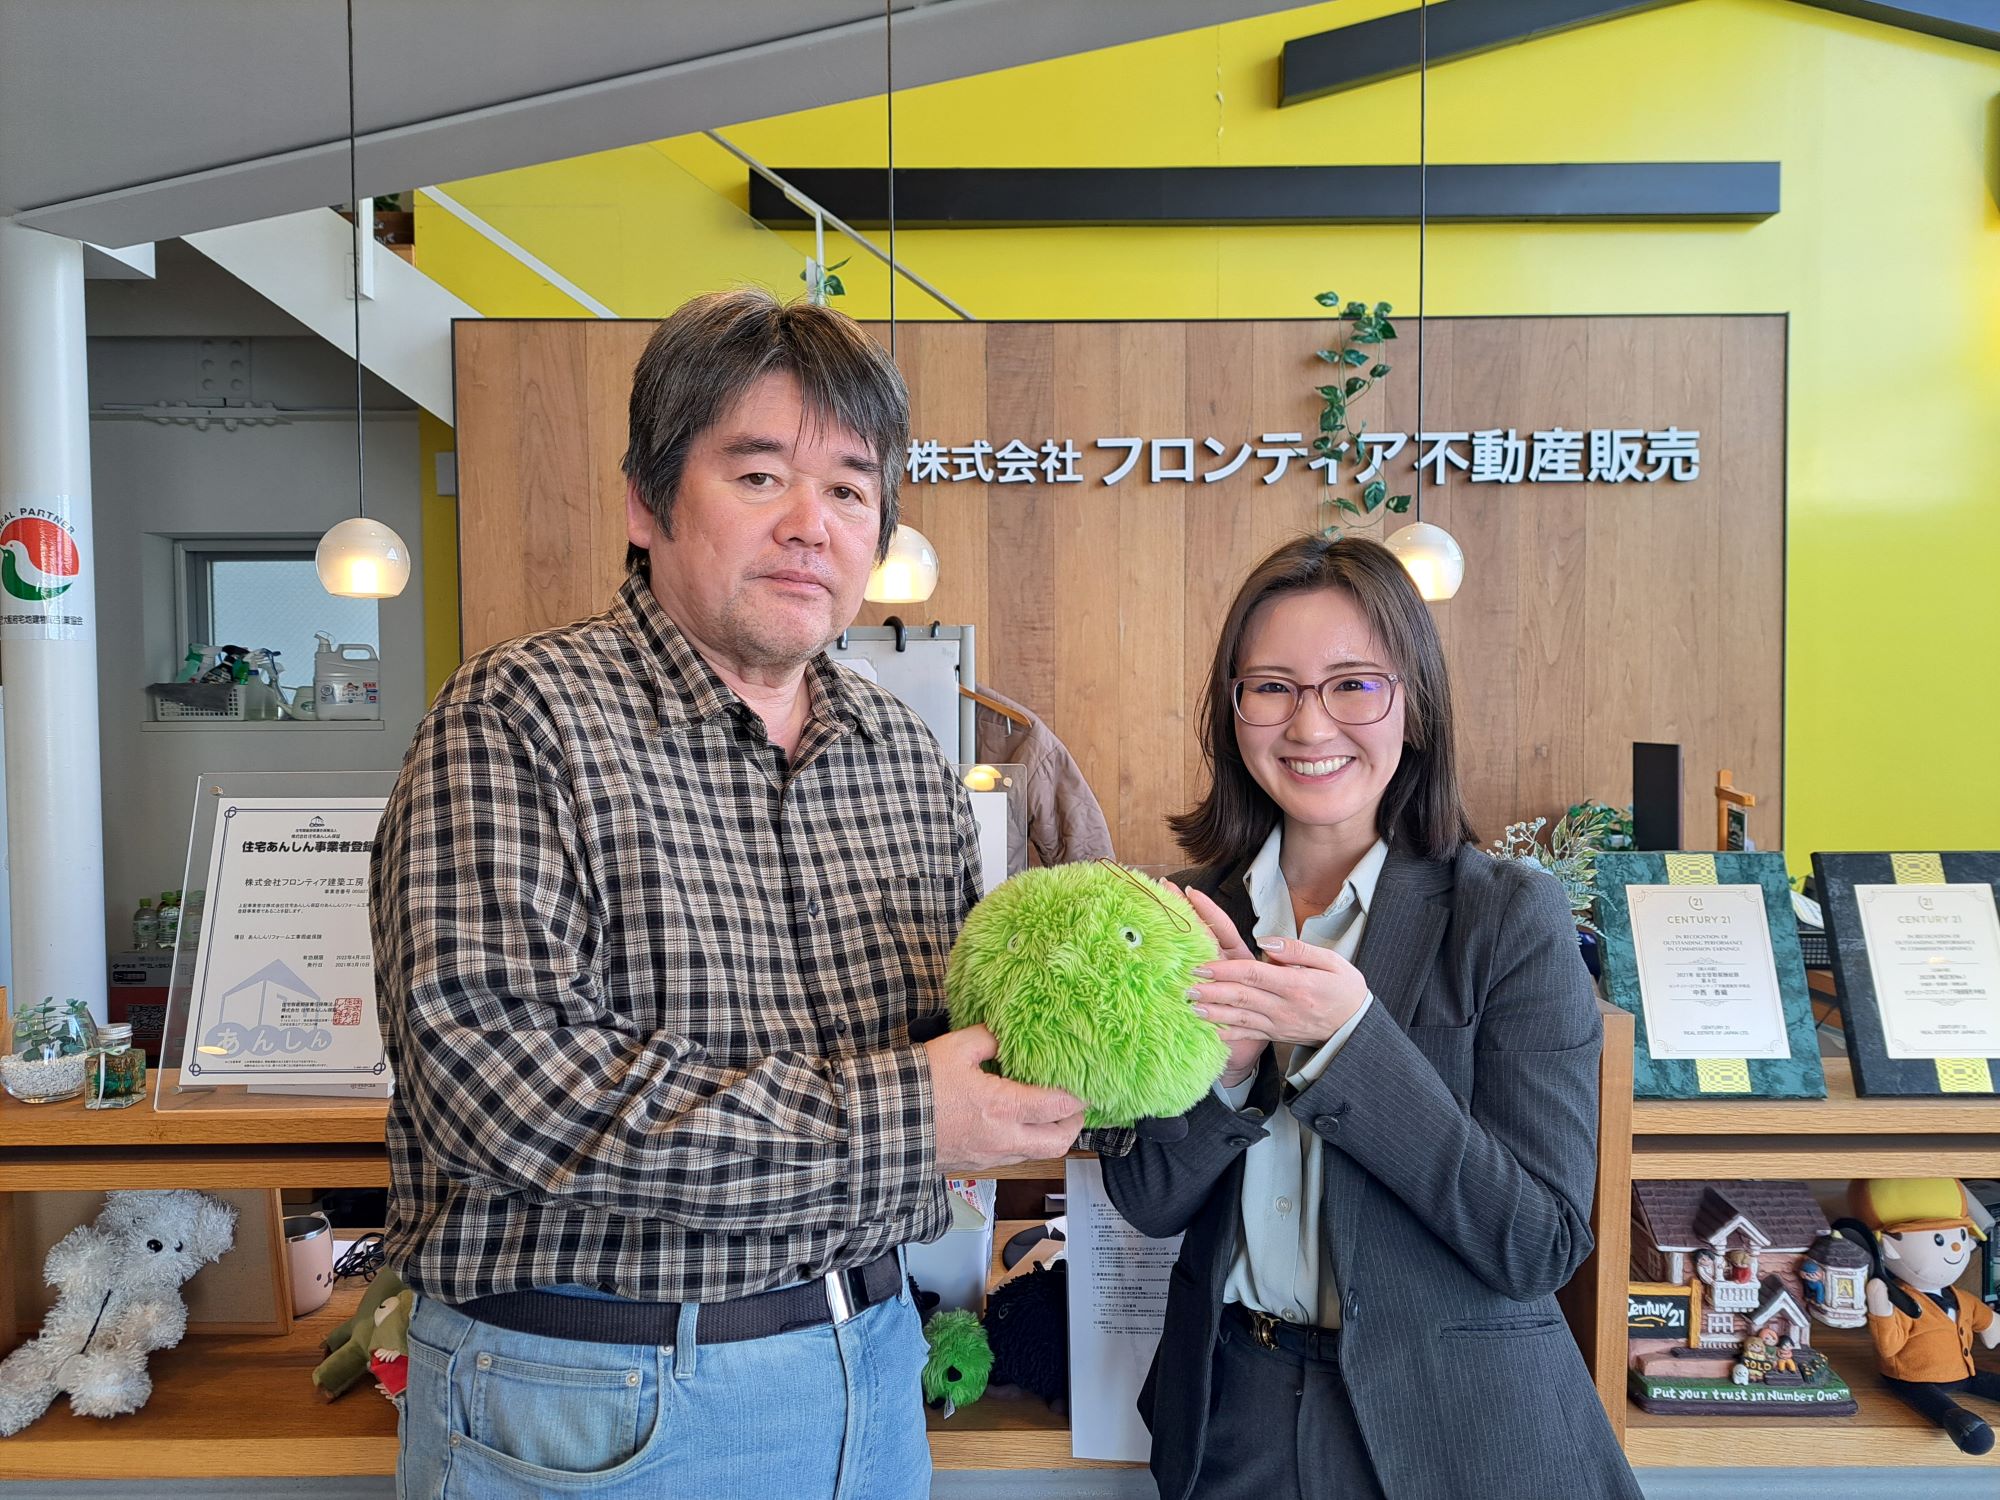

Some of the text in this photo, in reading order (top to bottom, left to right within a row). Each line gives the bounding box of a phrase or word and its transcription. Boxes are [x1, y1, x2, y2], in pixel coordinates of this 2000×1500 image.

[906, 438, 1084, 483] 株式会社
[0, 507, 75, 534] EAL PARTNER
[245, 878, 364, 887] 株式会社フロンティア建築工房
[1667, 915, 1731, 924] CENTURY 21
[1897, 915, 1962, 924] CENTURY 21
[217, 1028, 328, 1053] あんしん
[1628, 1299, 1685, 1327] Century 21
[1744, 1358, 1773, 1371] SOLD
[1652, 1387, 1677, 1399] Put
[1678, 1388, 1707, 1402] your
[1713, 1387, 1748, 1400] trust
[1750, 1389, 1765, 1401] in
[1767, 1389, 1814, 1402] Number
